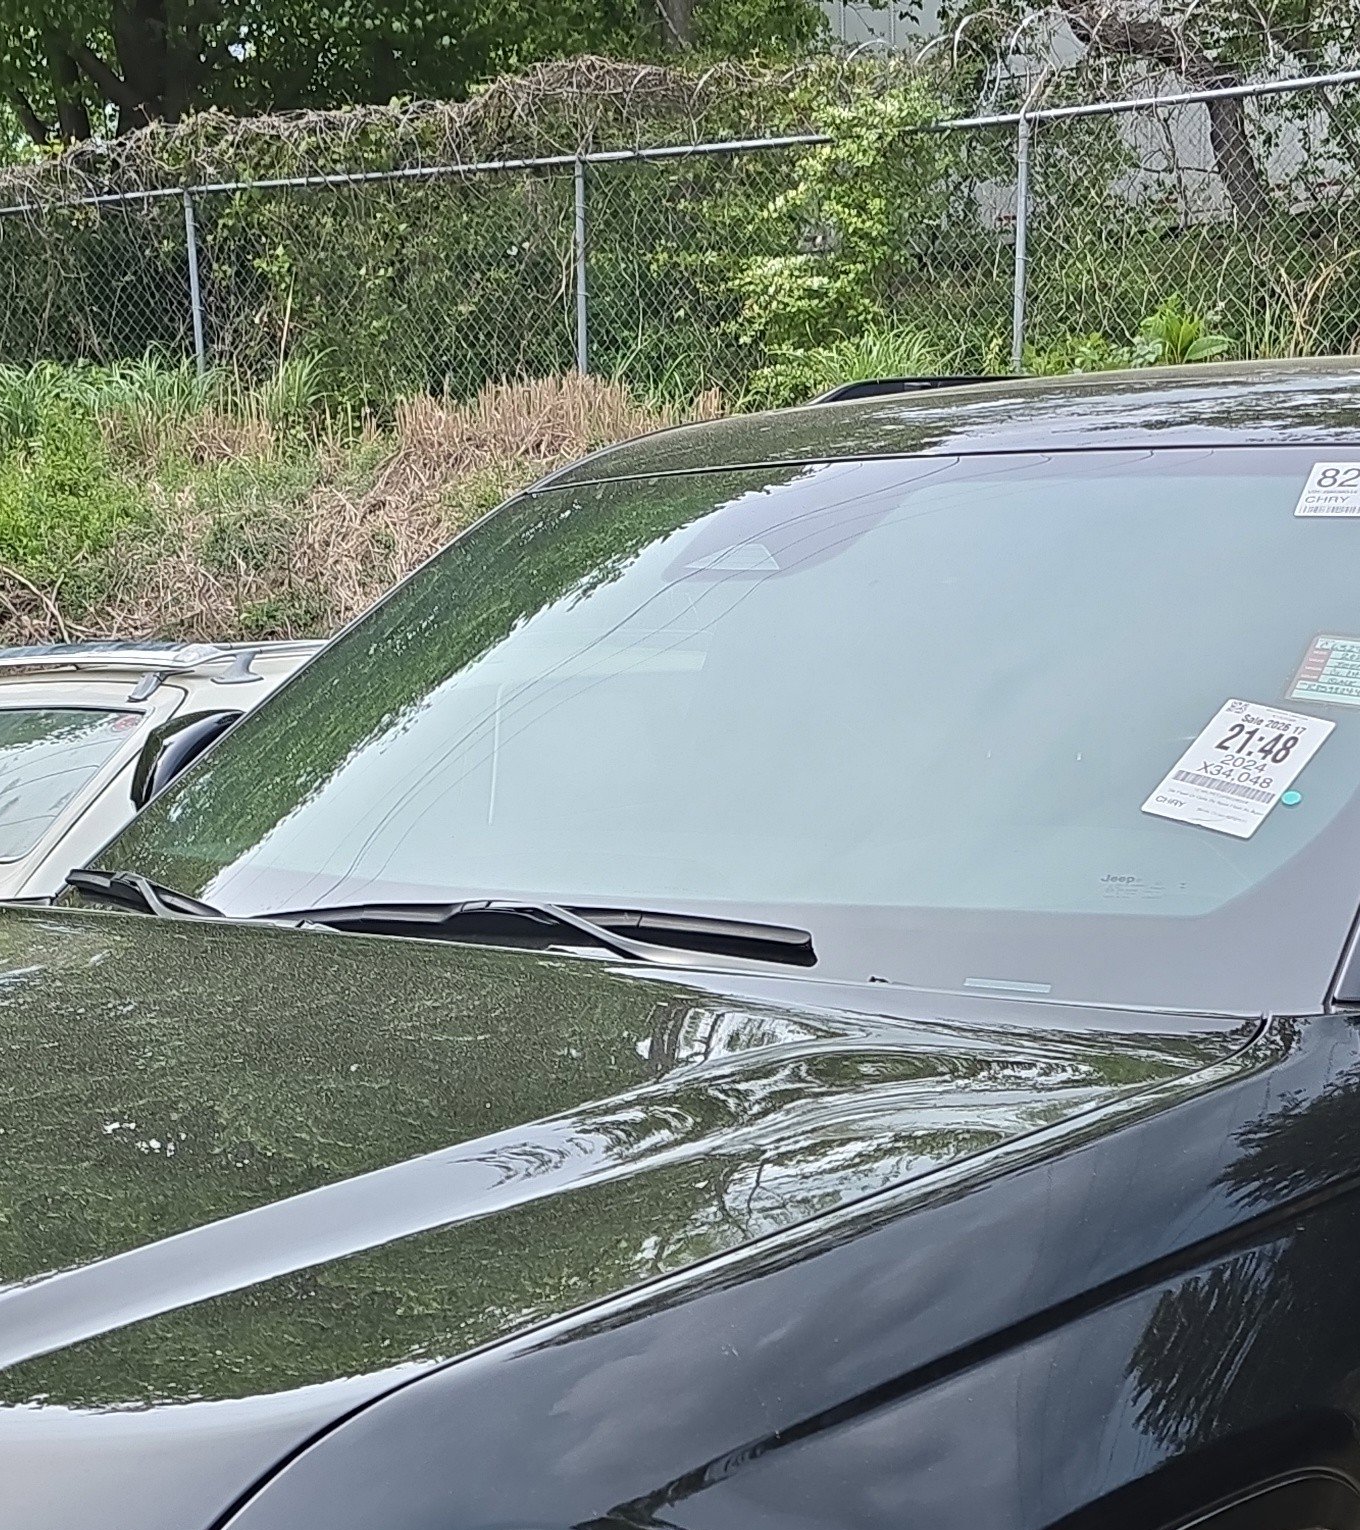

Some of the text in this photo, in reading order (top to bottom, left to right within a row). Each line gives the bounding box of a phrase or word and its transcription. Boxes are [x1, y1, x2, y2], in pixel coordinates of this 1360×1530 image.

[1241, 714, 1264, 725] Sale
[1293, 726, 1307, 735] 17
[1215, 723, 1299, 764] 21:48
[1221, 754, 1267, 773] 2024
[1100, 874, 1135, 883] Jeep
